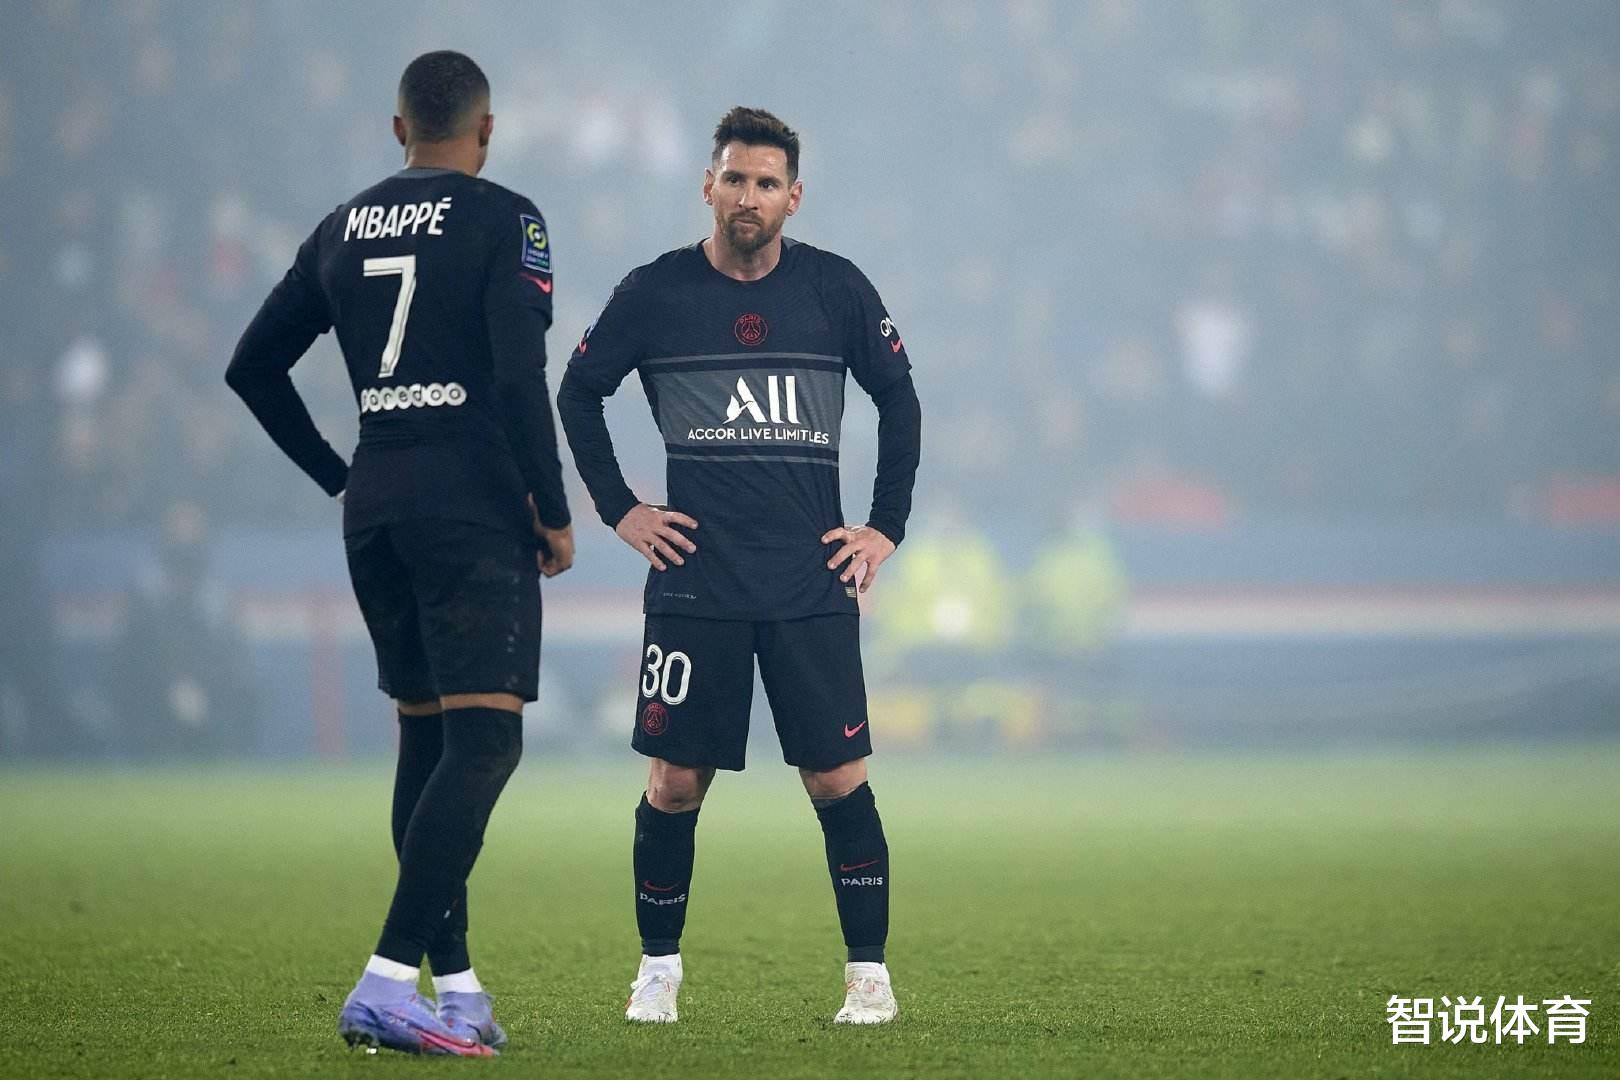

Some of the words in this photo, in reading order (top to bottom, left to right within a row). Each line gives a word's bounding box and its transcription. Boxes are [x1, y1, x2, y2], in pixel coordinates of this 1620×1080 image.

[344, 197, 452, 241] MBAPPÉ
[363, 255, 416, 378] 7
[687, 428, 736, 440] ACCOR
[740, 428, 772, 440] LIVE
[642, 644, 691, 705] 30
[841, 877, 883, 886] PARIS
